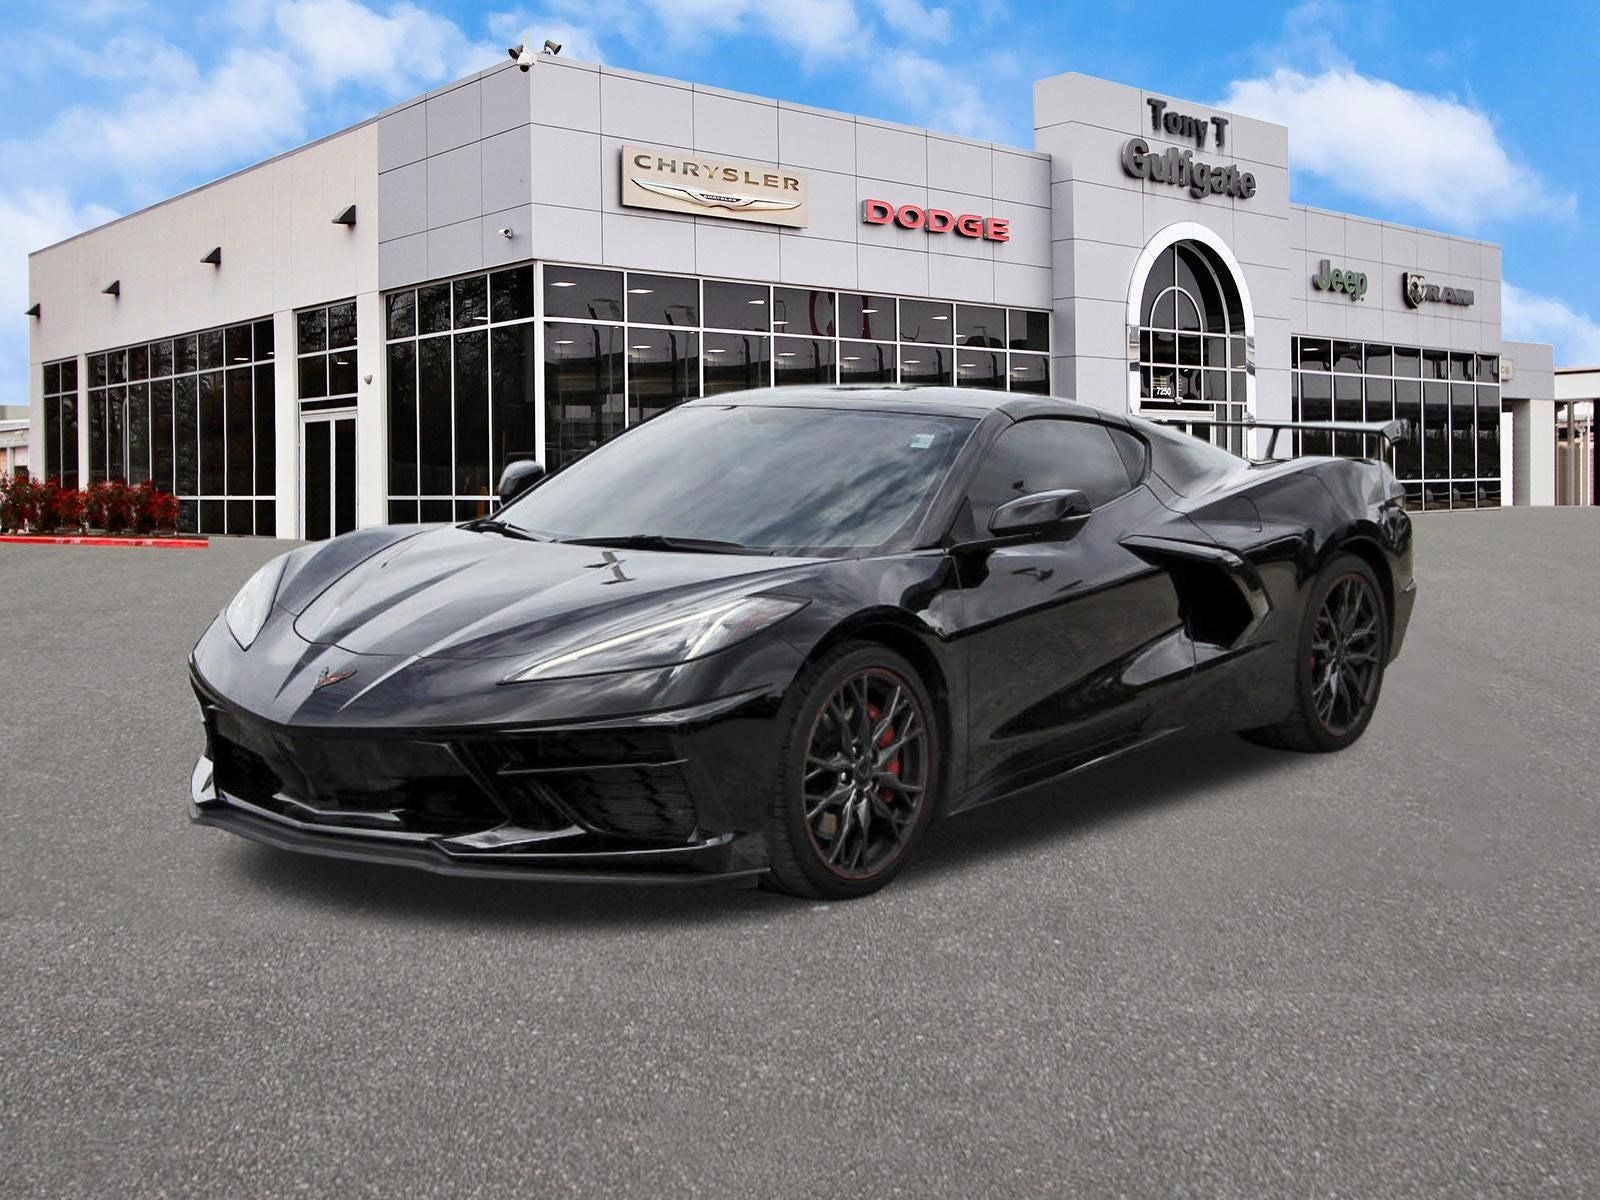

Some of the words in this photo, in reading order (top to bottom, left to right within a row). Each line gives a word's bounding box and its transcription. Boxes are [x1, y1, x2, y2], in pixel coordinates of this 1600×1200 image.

[1147, 98, 1208, 147] Tony
[1211, 116, 1229, 147] T
[634, 154, 799, 191] CHRYSLER
[1121, 137, 1256, 199] Gulfgate
[862, 198, 1010, 242] DODGE
[1312, 259, 1368, 302] Jeep
[1423, 283, 1474, 306] RAM
